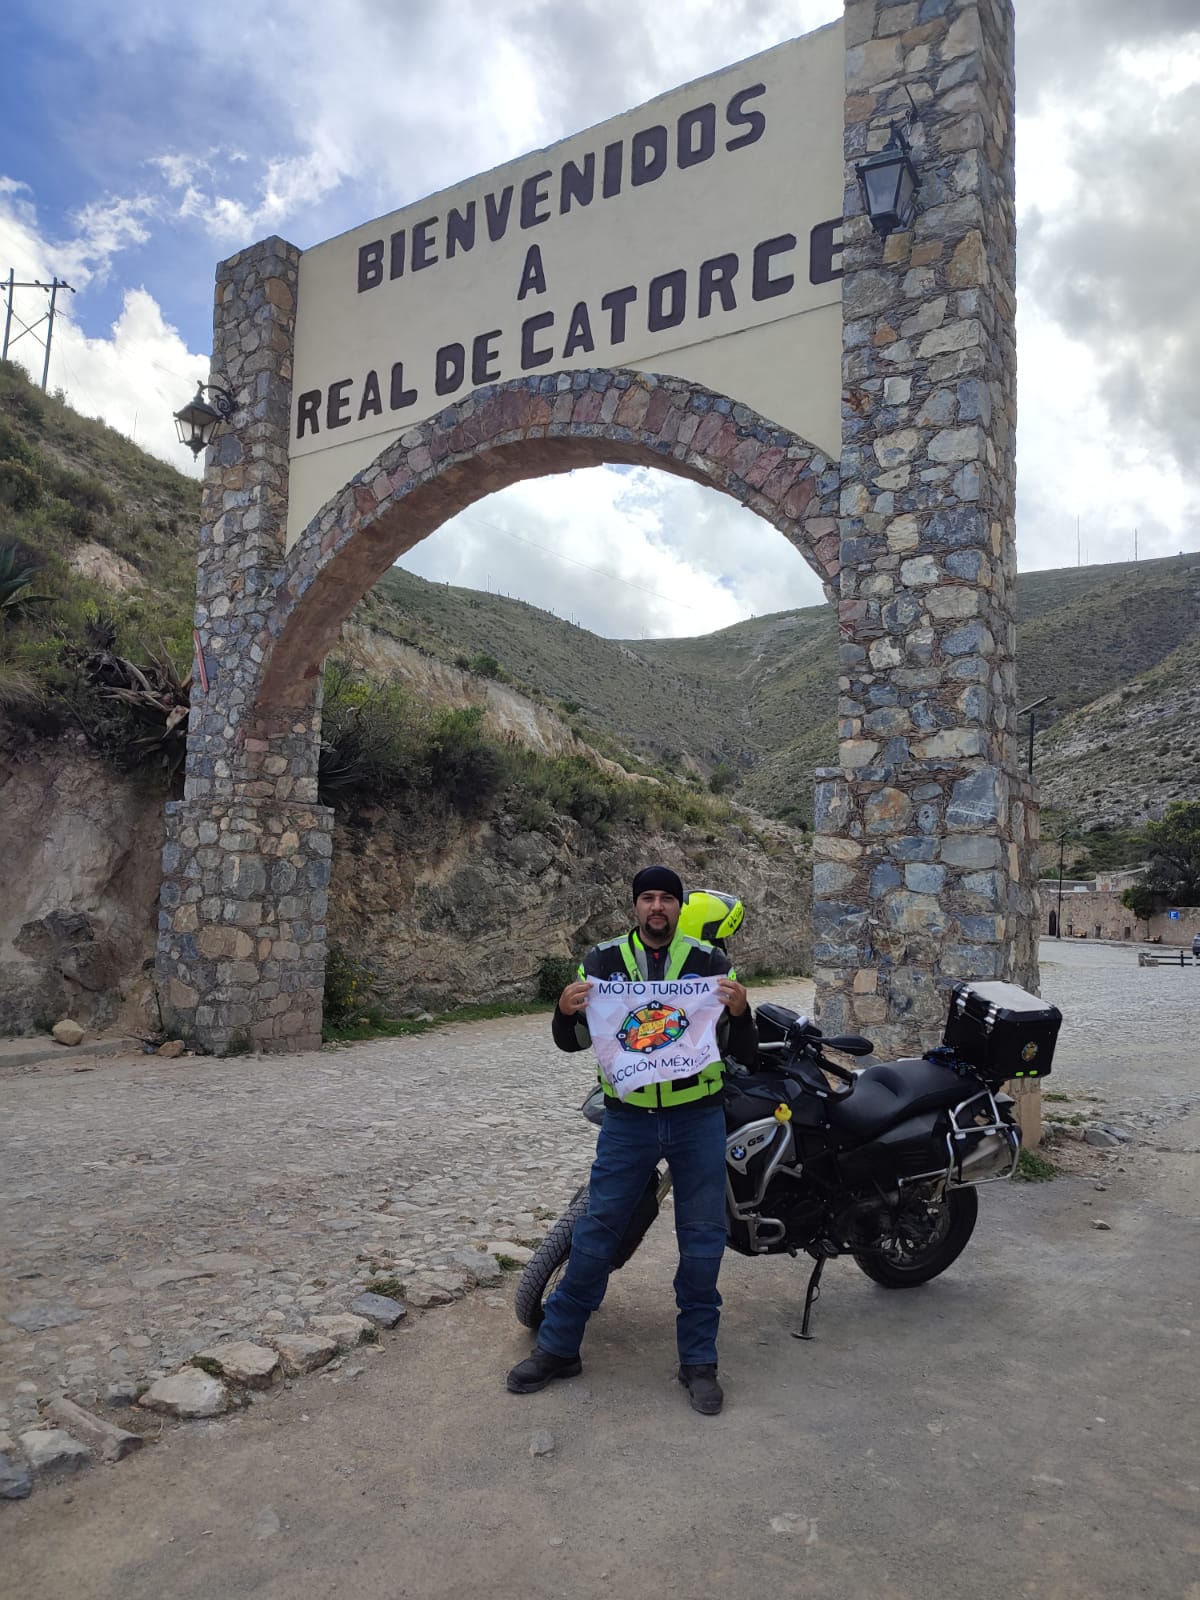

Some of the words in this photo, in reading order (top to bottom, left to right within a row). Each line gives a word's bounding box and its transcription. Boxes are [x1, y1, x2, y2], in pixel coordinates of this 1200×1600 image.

[357, 82, 767, 295] BIENVENIDOS
[516, 243, 548, 301] A
[295, 360, 419, 440] REAL
[434, 328, 503, 396] DE
[520, 215, 844, 371] CATORCE
[598, 982, 646, 995] MOTO
[650, 982, 711, 995] TURISTA
[612, 1058, 657, 1085] ACCIÓN
[747, 1134, 765, 1147] GS
